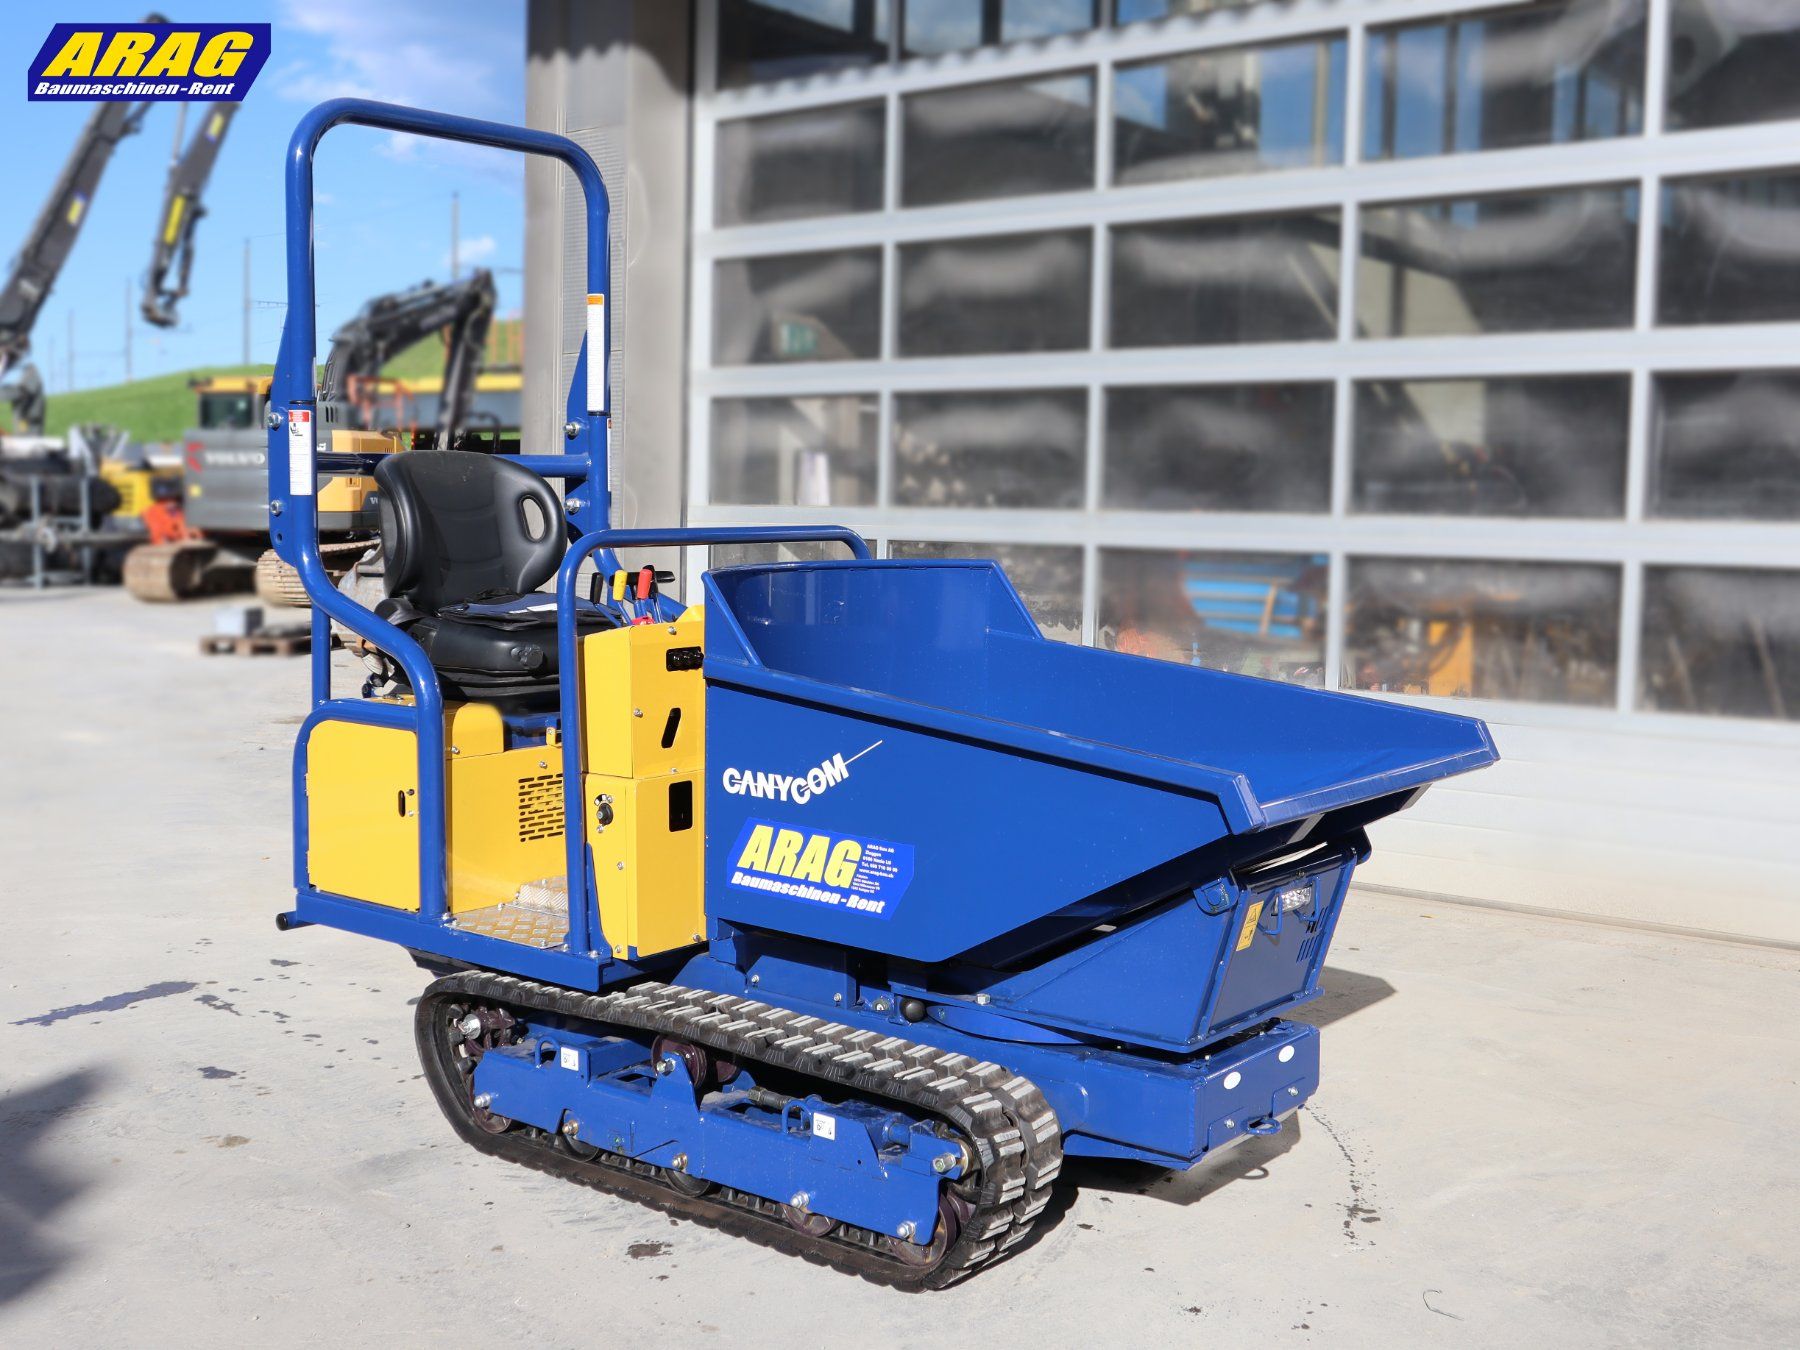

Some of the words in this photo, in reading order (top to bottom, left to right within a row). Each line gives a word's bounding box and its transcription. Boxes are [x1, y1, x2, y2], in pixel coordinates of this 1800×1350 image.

[722, 752, 850, 805] CANYCOM
[736, 824, 863, 889] ARAG
[731, 871, 886, 914] Baumaschinen-Rent
